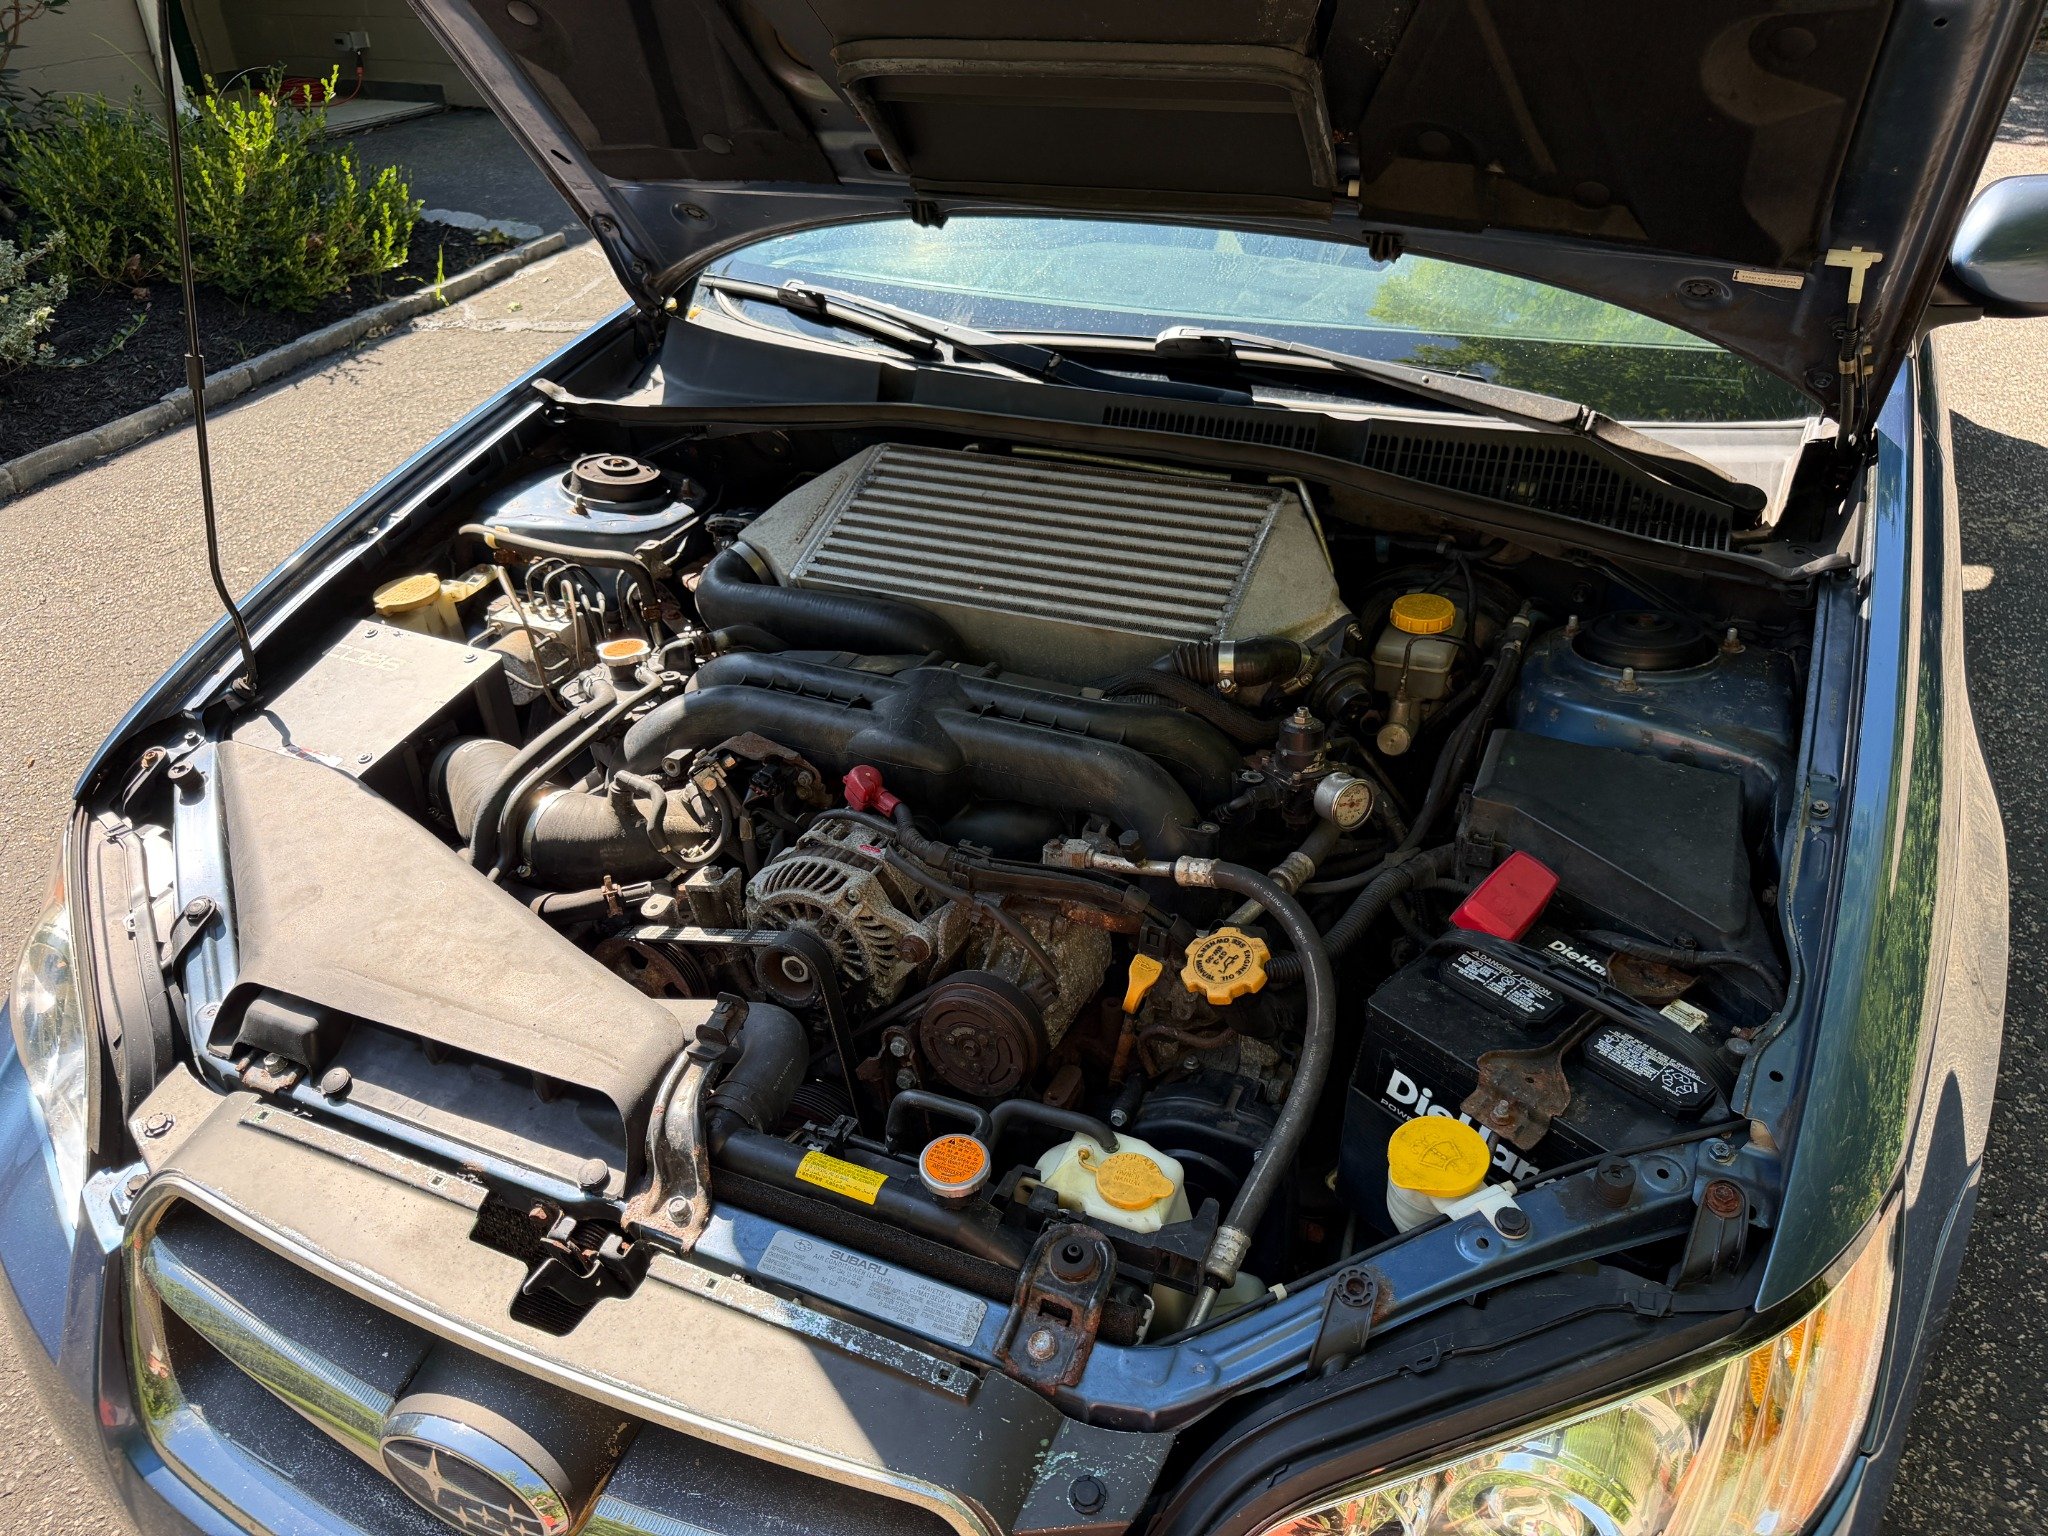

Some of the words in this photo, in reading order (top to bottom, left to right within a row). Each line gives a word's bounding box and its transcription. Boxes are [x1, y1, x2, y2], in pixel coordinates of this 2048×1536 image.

[1196, 960, 1215, 980] MANUAL
[1235, 949, 1251, 976] ENGINE
[1548, 940, 1607, 976] DieHa
[1221, 973, 1235, 981] OIL
[1480, 954, 1514, 976] DANGER
[1520, 976, 1551, 996] POISON
[812, 1253, 824, 1263] AIR
[824, 1256, 866, 1277] CONDITIONER
[829, 1249, 890, 1276] SUBARU
